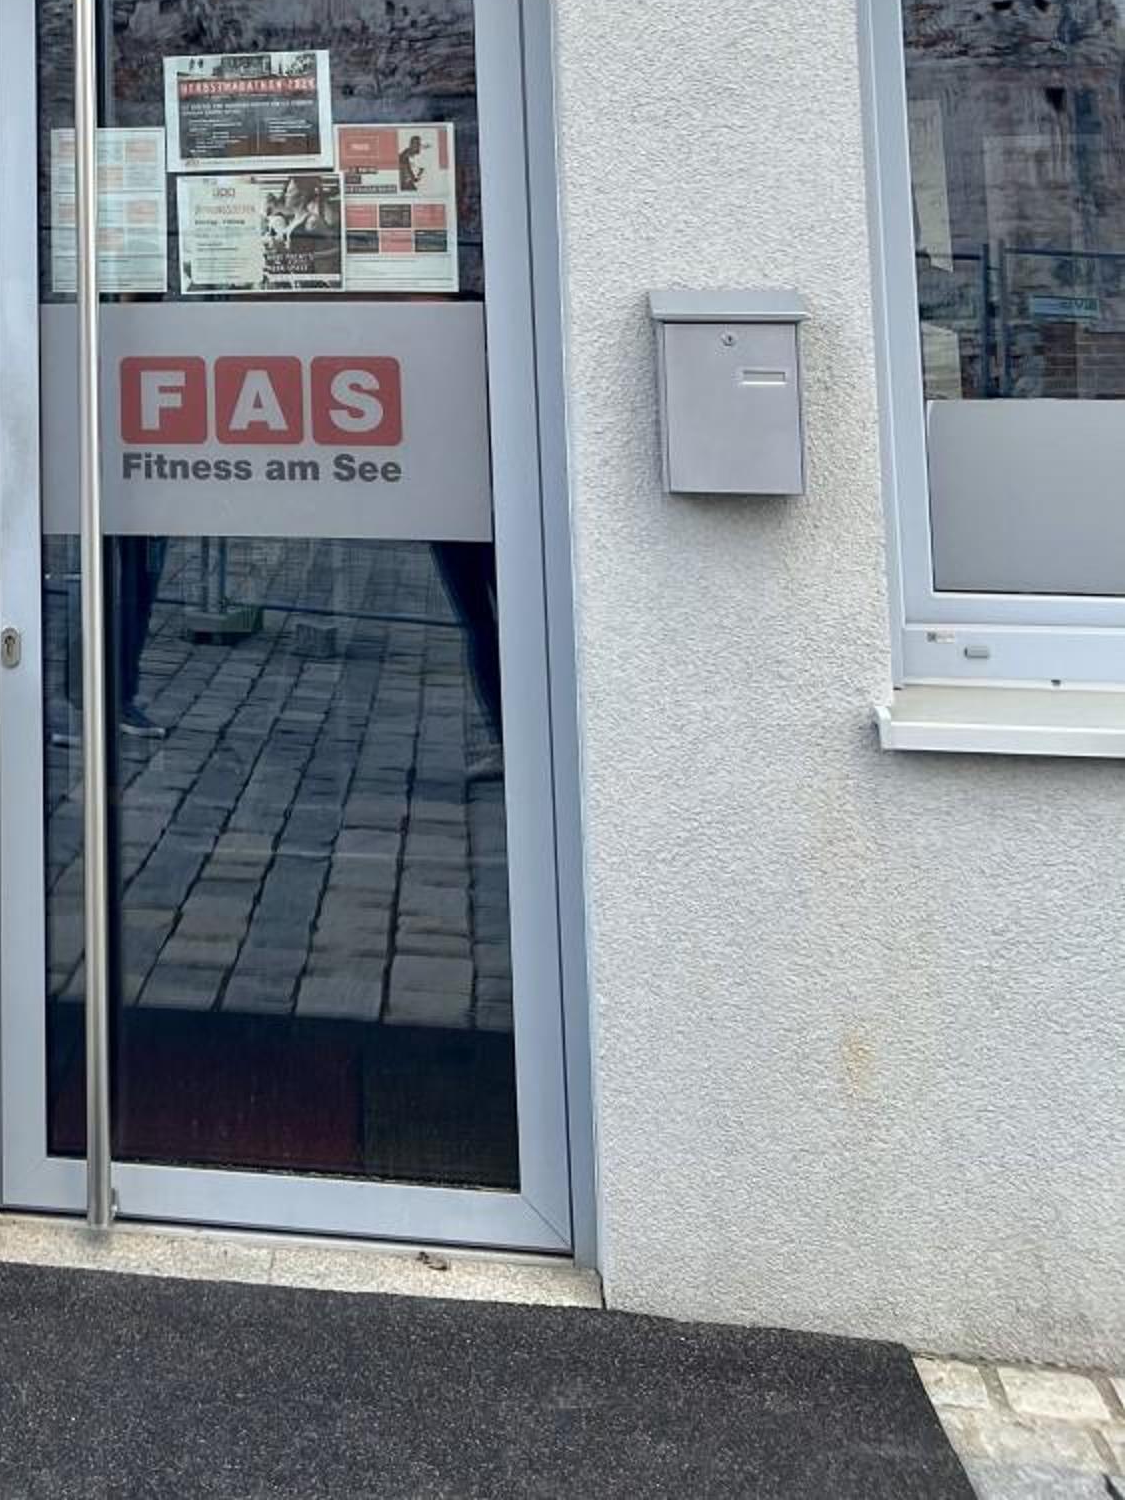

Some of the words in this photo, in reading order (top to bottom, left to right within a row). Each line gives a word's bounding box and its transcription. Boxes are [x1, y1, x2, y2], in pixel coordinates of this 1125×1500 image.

[139, 368, 384, 433] FAS
[122, 452, 252, 481] Fitness
[266, 458, 320, 481] am
[333, 453, 402, 482] See
